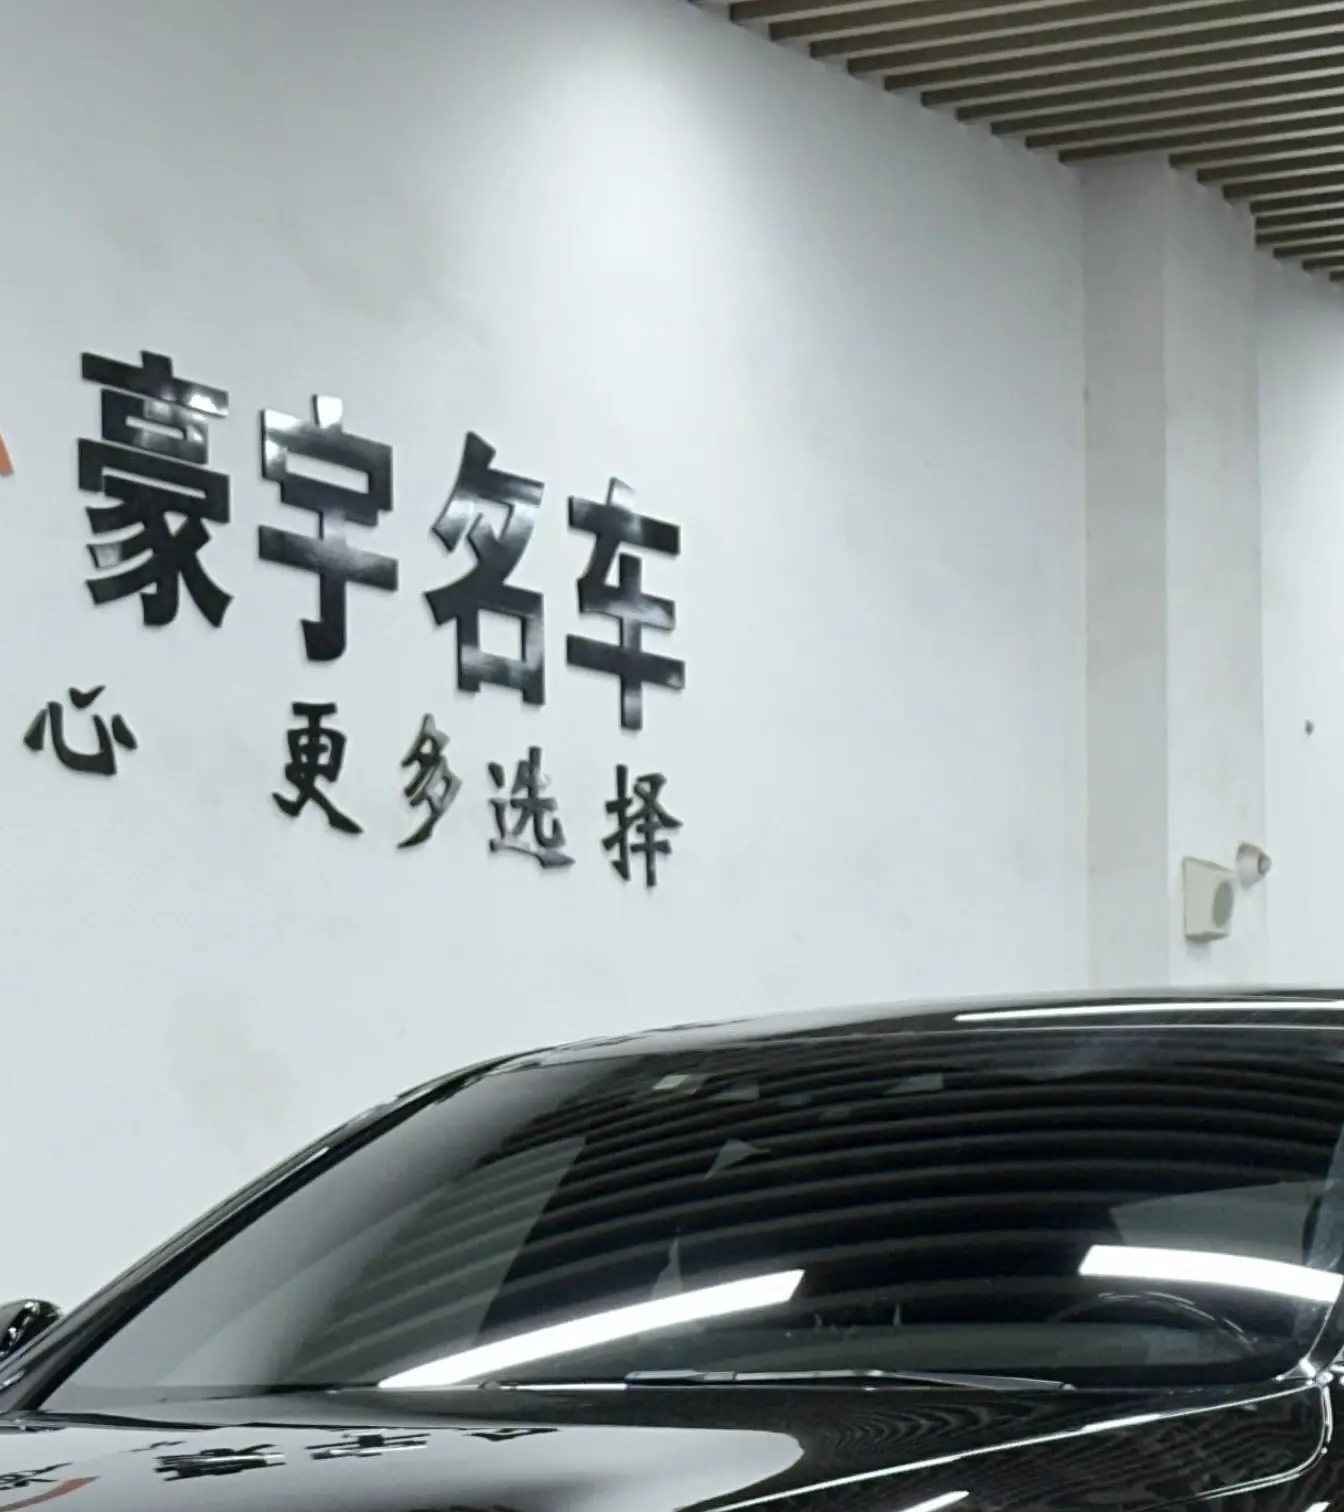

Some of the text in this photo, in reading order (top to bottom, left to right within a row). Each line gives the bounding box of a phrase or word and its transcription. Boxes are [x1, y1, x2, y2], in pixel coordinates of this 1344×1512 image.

[78, 350, 686, 731] 豪宇名车
[271, 701, 684, 888] 更多选择
